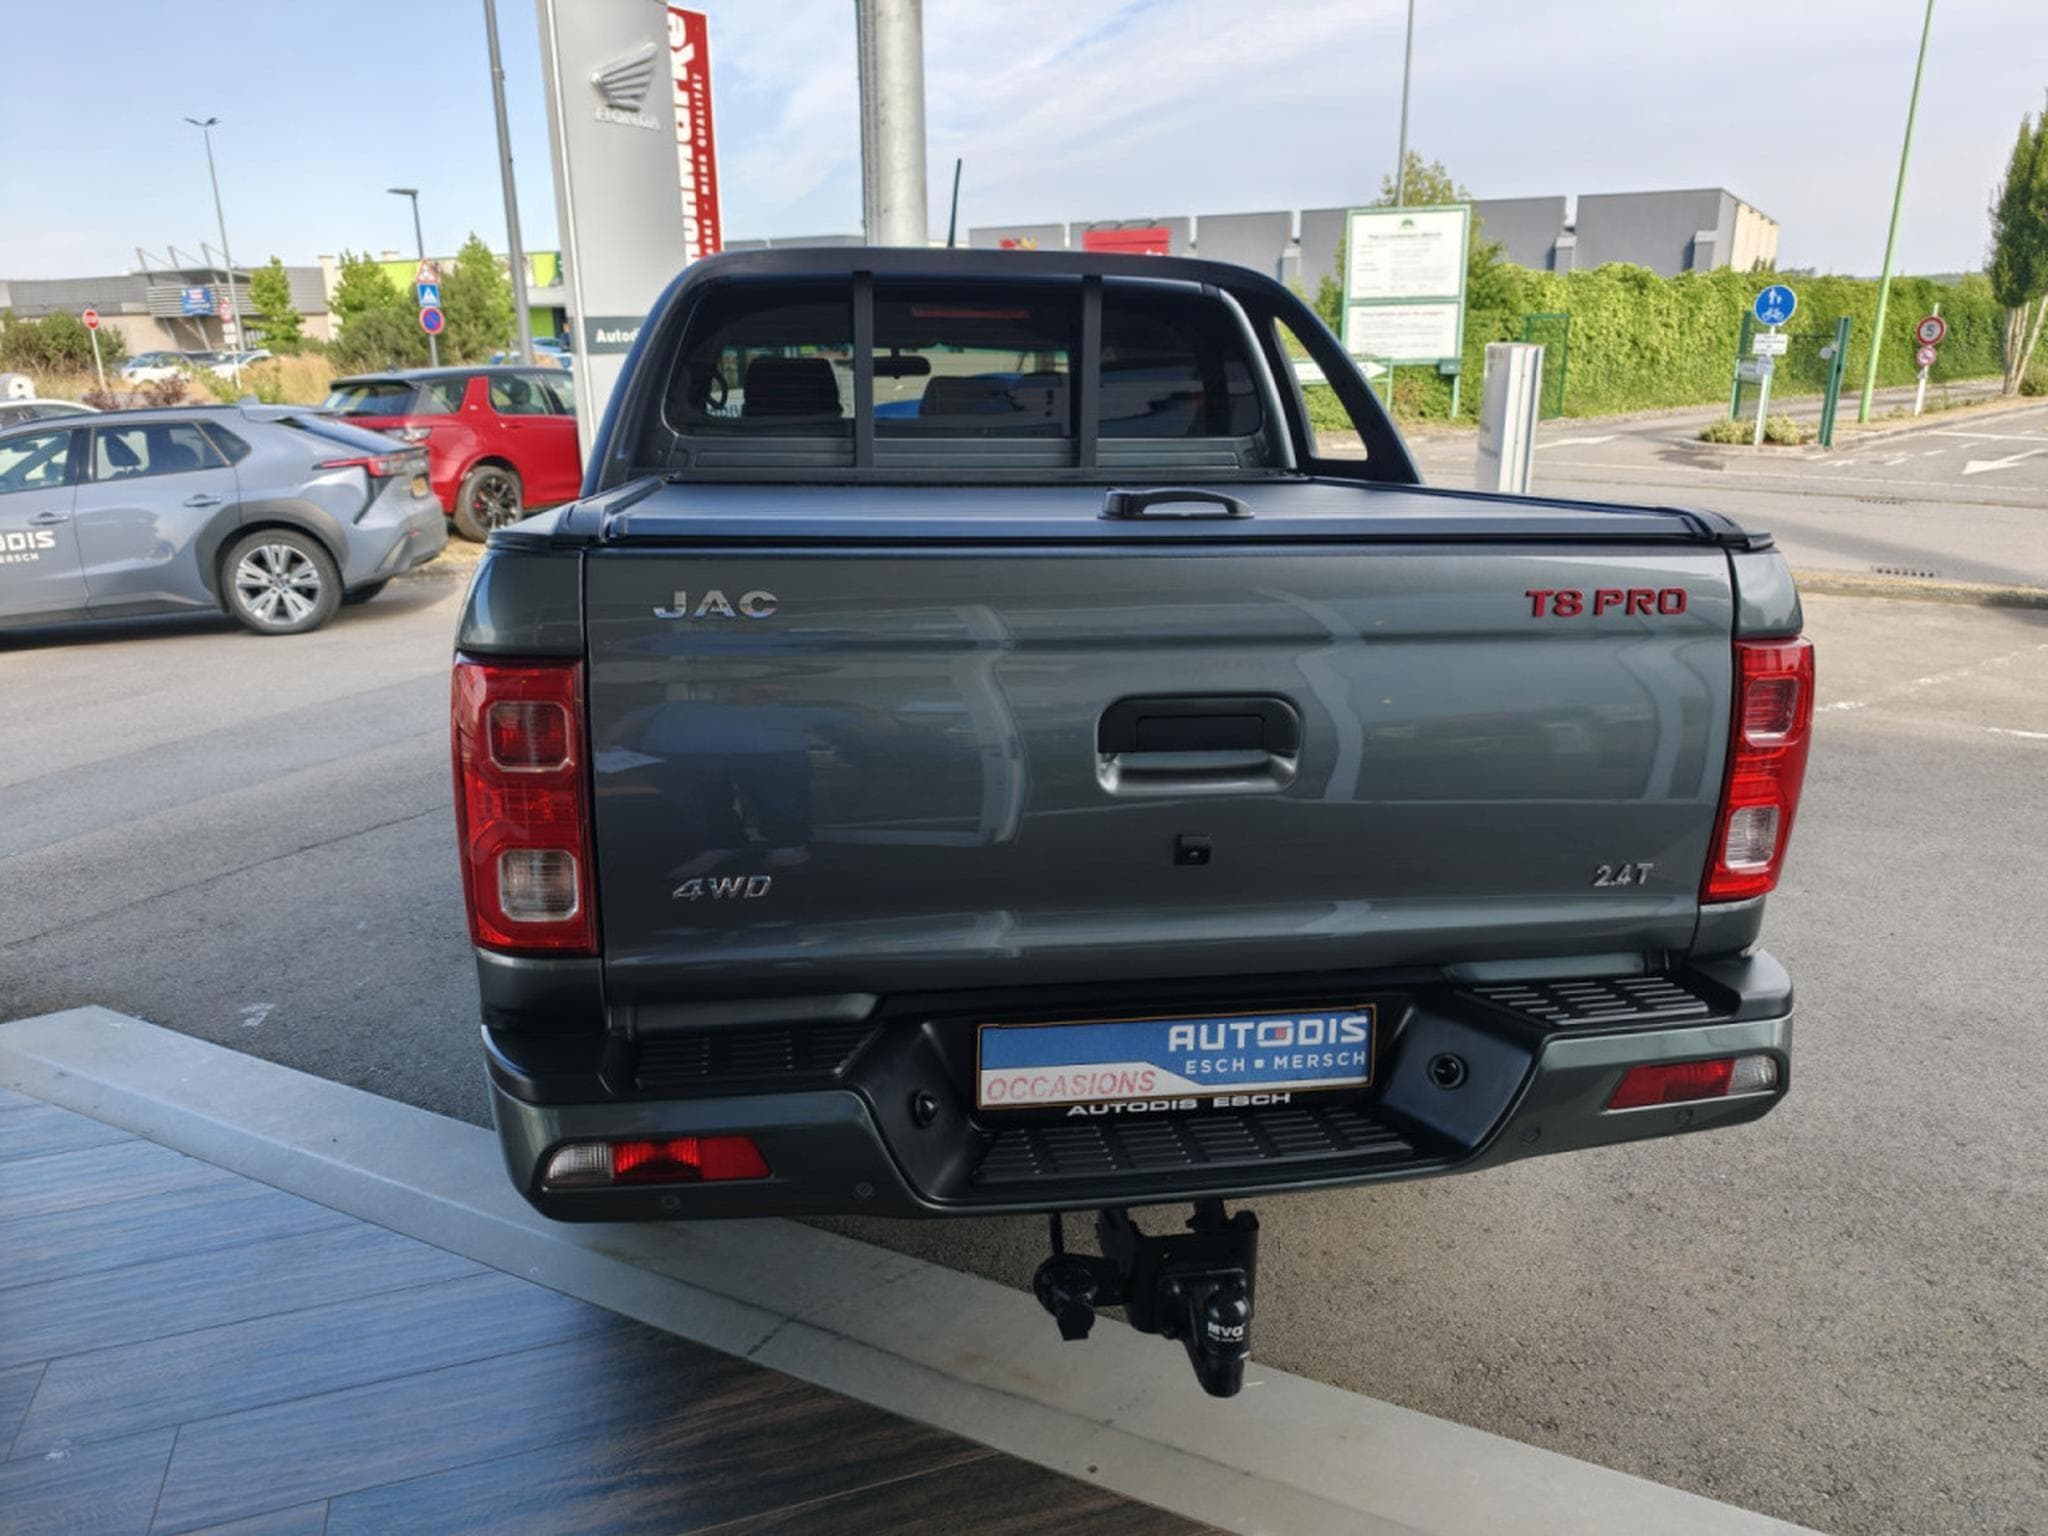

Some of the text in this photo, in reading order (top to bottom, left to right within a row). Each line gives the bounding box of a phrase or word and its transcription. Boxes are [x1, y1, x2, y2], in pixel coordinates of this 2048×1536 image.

[653, 590, 778, 618] JAC
[1525, 587, 1688, 618] T8 PRO
[1593, 862, 1654, 887] 2.4T
[672, 876, 771, 901] 4WD
[1168, 1016, 1369, 1052] AUTODIS
[1185, 1051, 1366, 1075] ESCH MERSCH
[987, 1069, 1157, 1102] OCCASIONS
[1066, 1093, 1292, 1117] AUTODIS ESCH
